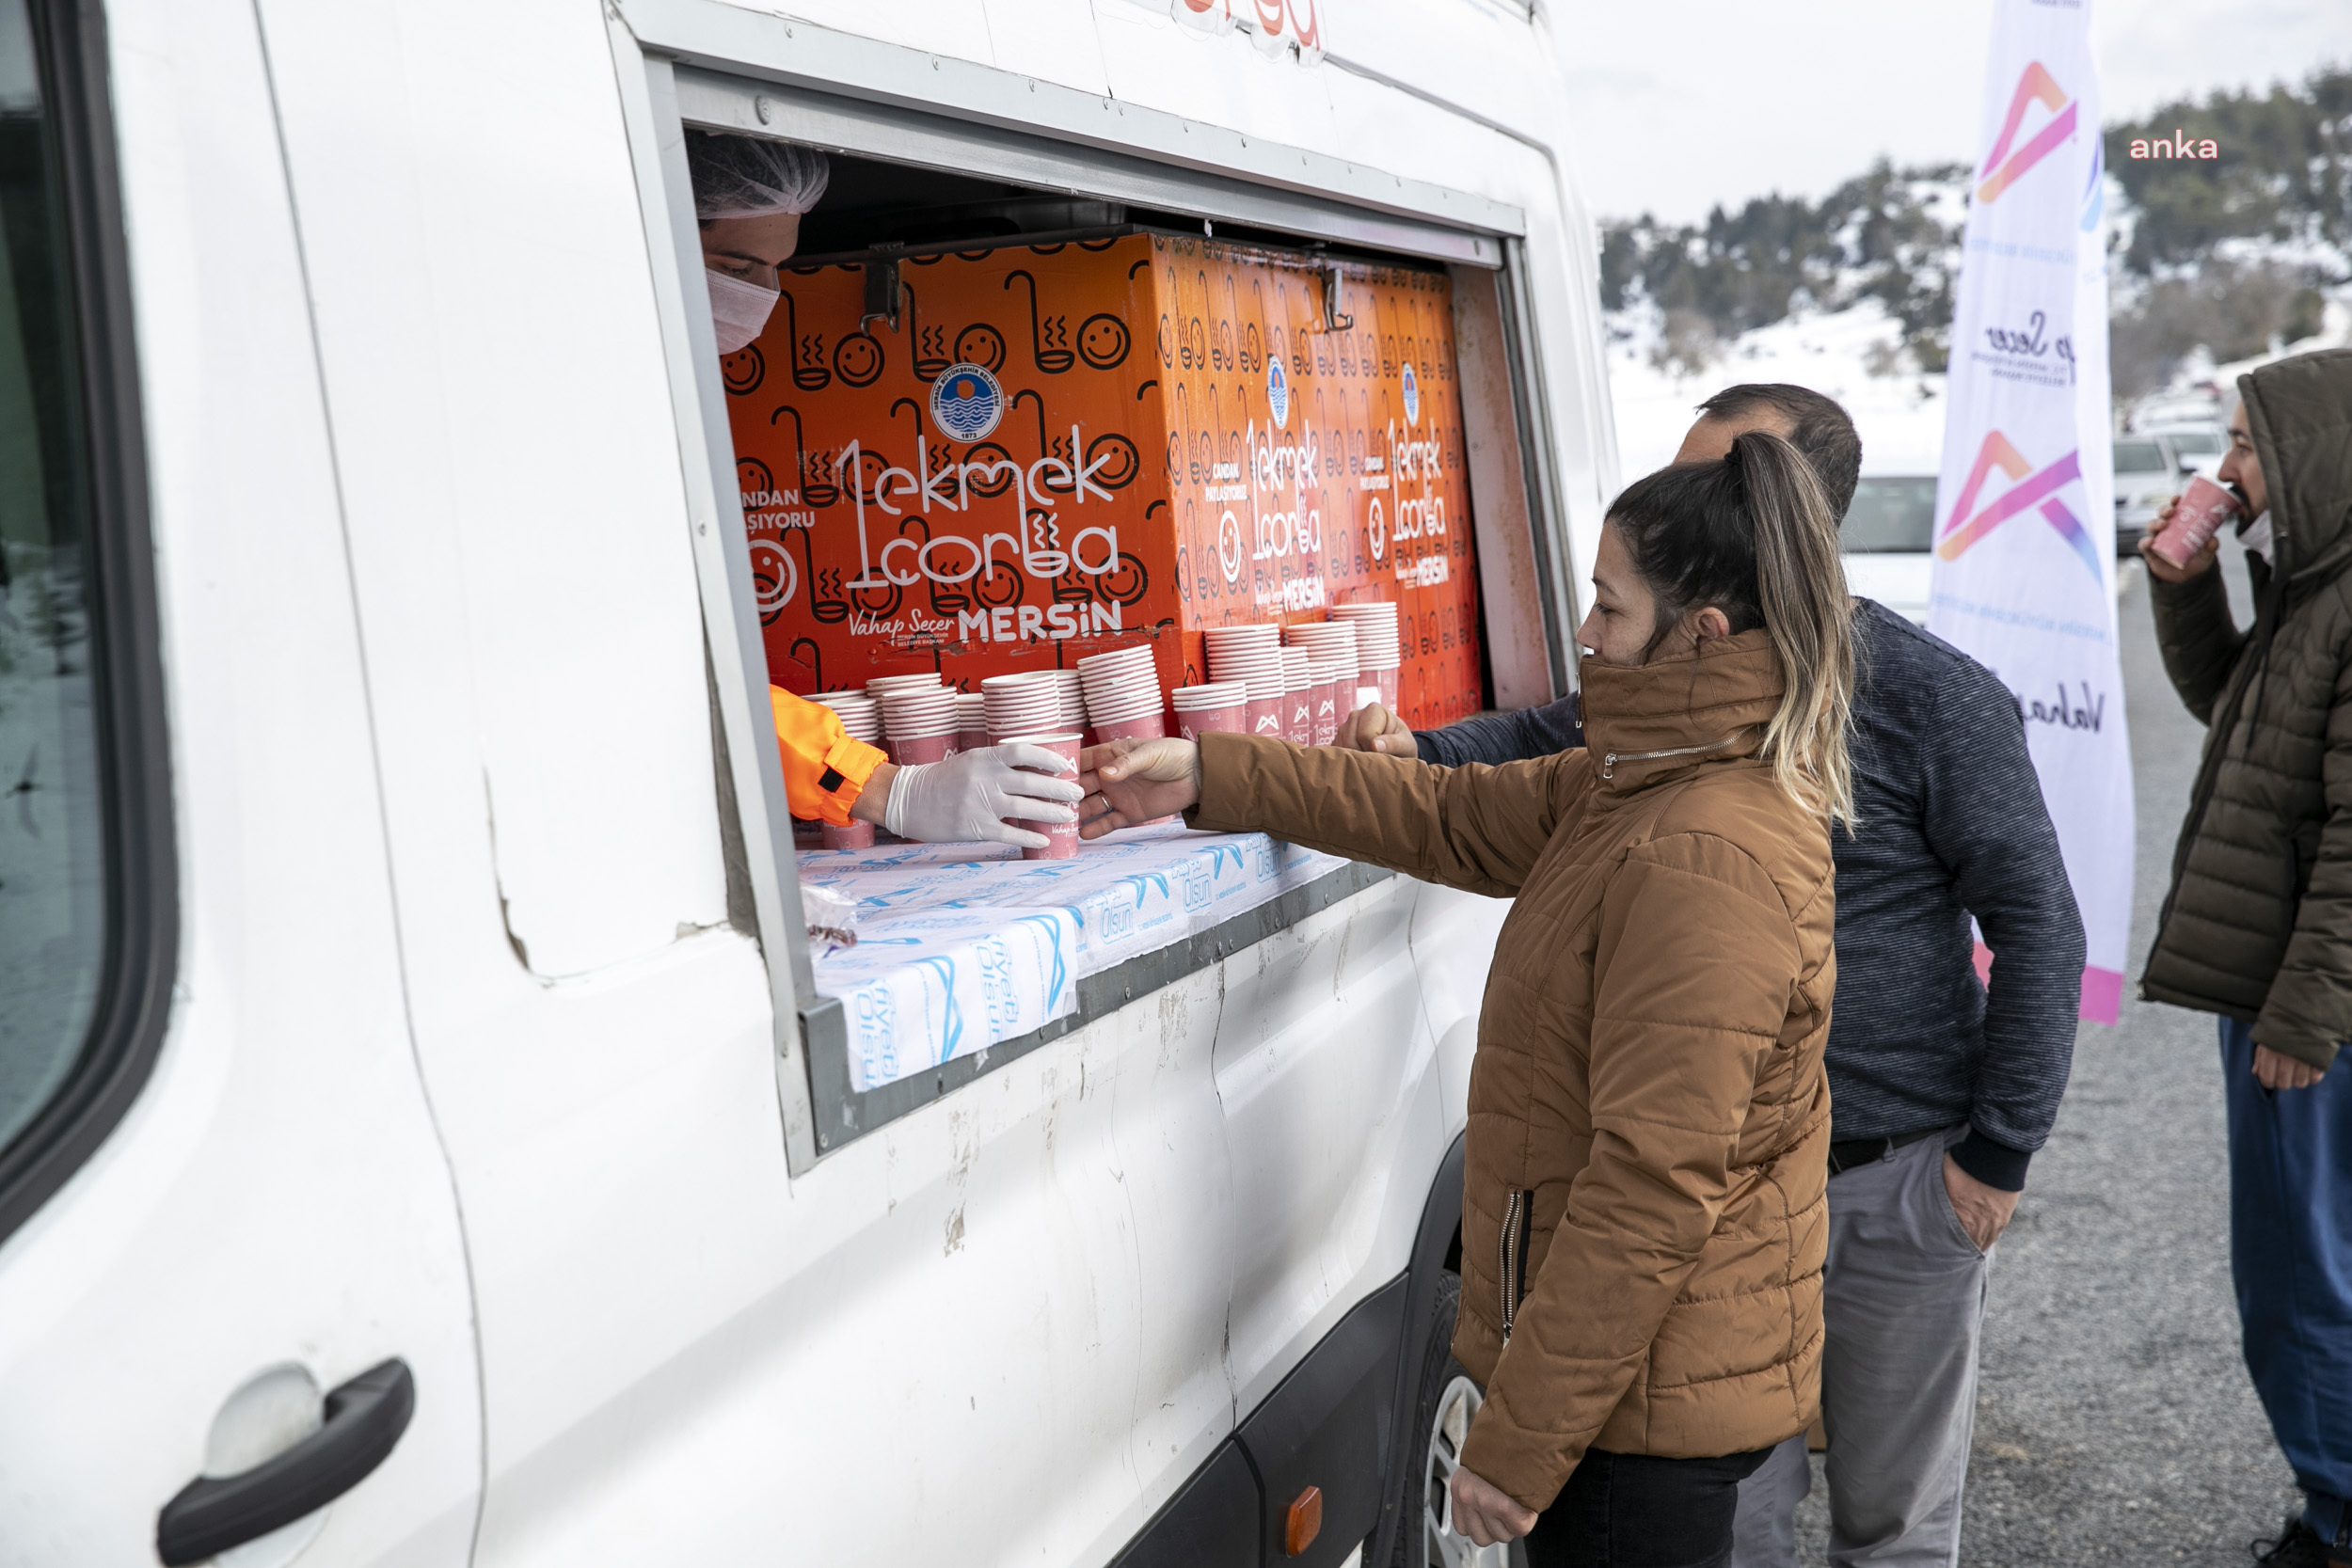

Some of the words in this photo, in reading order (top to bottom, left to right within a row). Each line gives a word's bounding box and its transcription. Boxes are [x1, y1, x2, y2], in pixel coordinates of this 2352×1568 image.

[874, 424, 1114, 515] ekmek
[740, 489, 800, 508] NDAN
[746, 511, 816, 535] ŞIYORU
[849, 609, 905, 647] Vahap
[908, 608, 956, 633] Seçer
